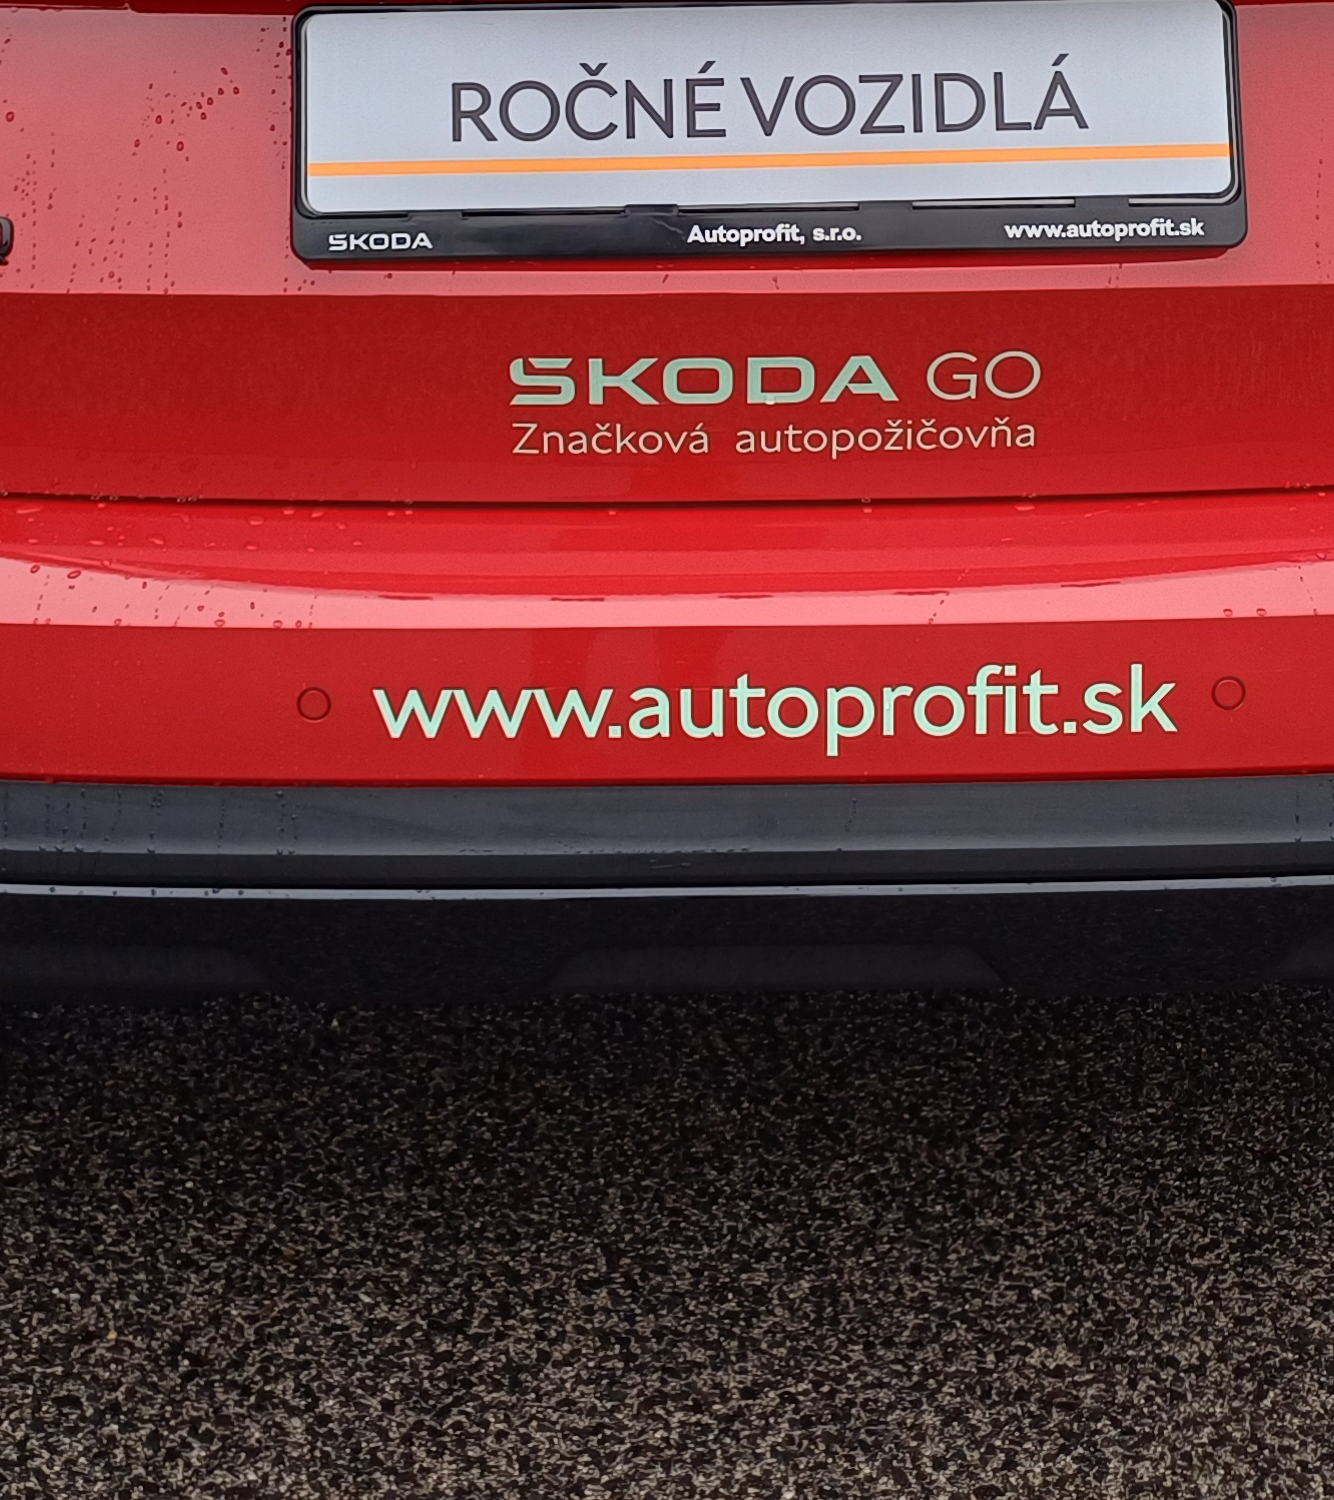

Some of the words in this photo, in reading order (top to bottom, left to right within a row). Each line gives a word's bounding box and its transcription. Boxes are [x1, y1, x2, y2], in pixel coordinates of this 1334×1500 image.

[451, 61, 727, 143] ROČNÉ
[740, 53, 1089, 138] VOZIDLÁ
[687, 224, 805, 246] Autoprofit,
[812, 227, 862, 242] s.r.o.
[1004, 217, 1205, 242] www.autoprofit.sk
[926, 350, 1042, 401] GO
[511, 422, 710, 455] Značková
[736, 417, 1036, 460] autopožičovňa
[373, 663, 1179, 757] www.autoprofit.sk
